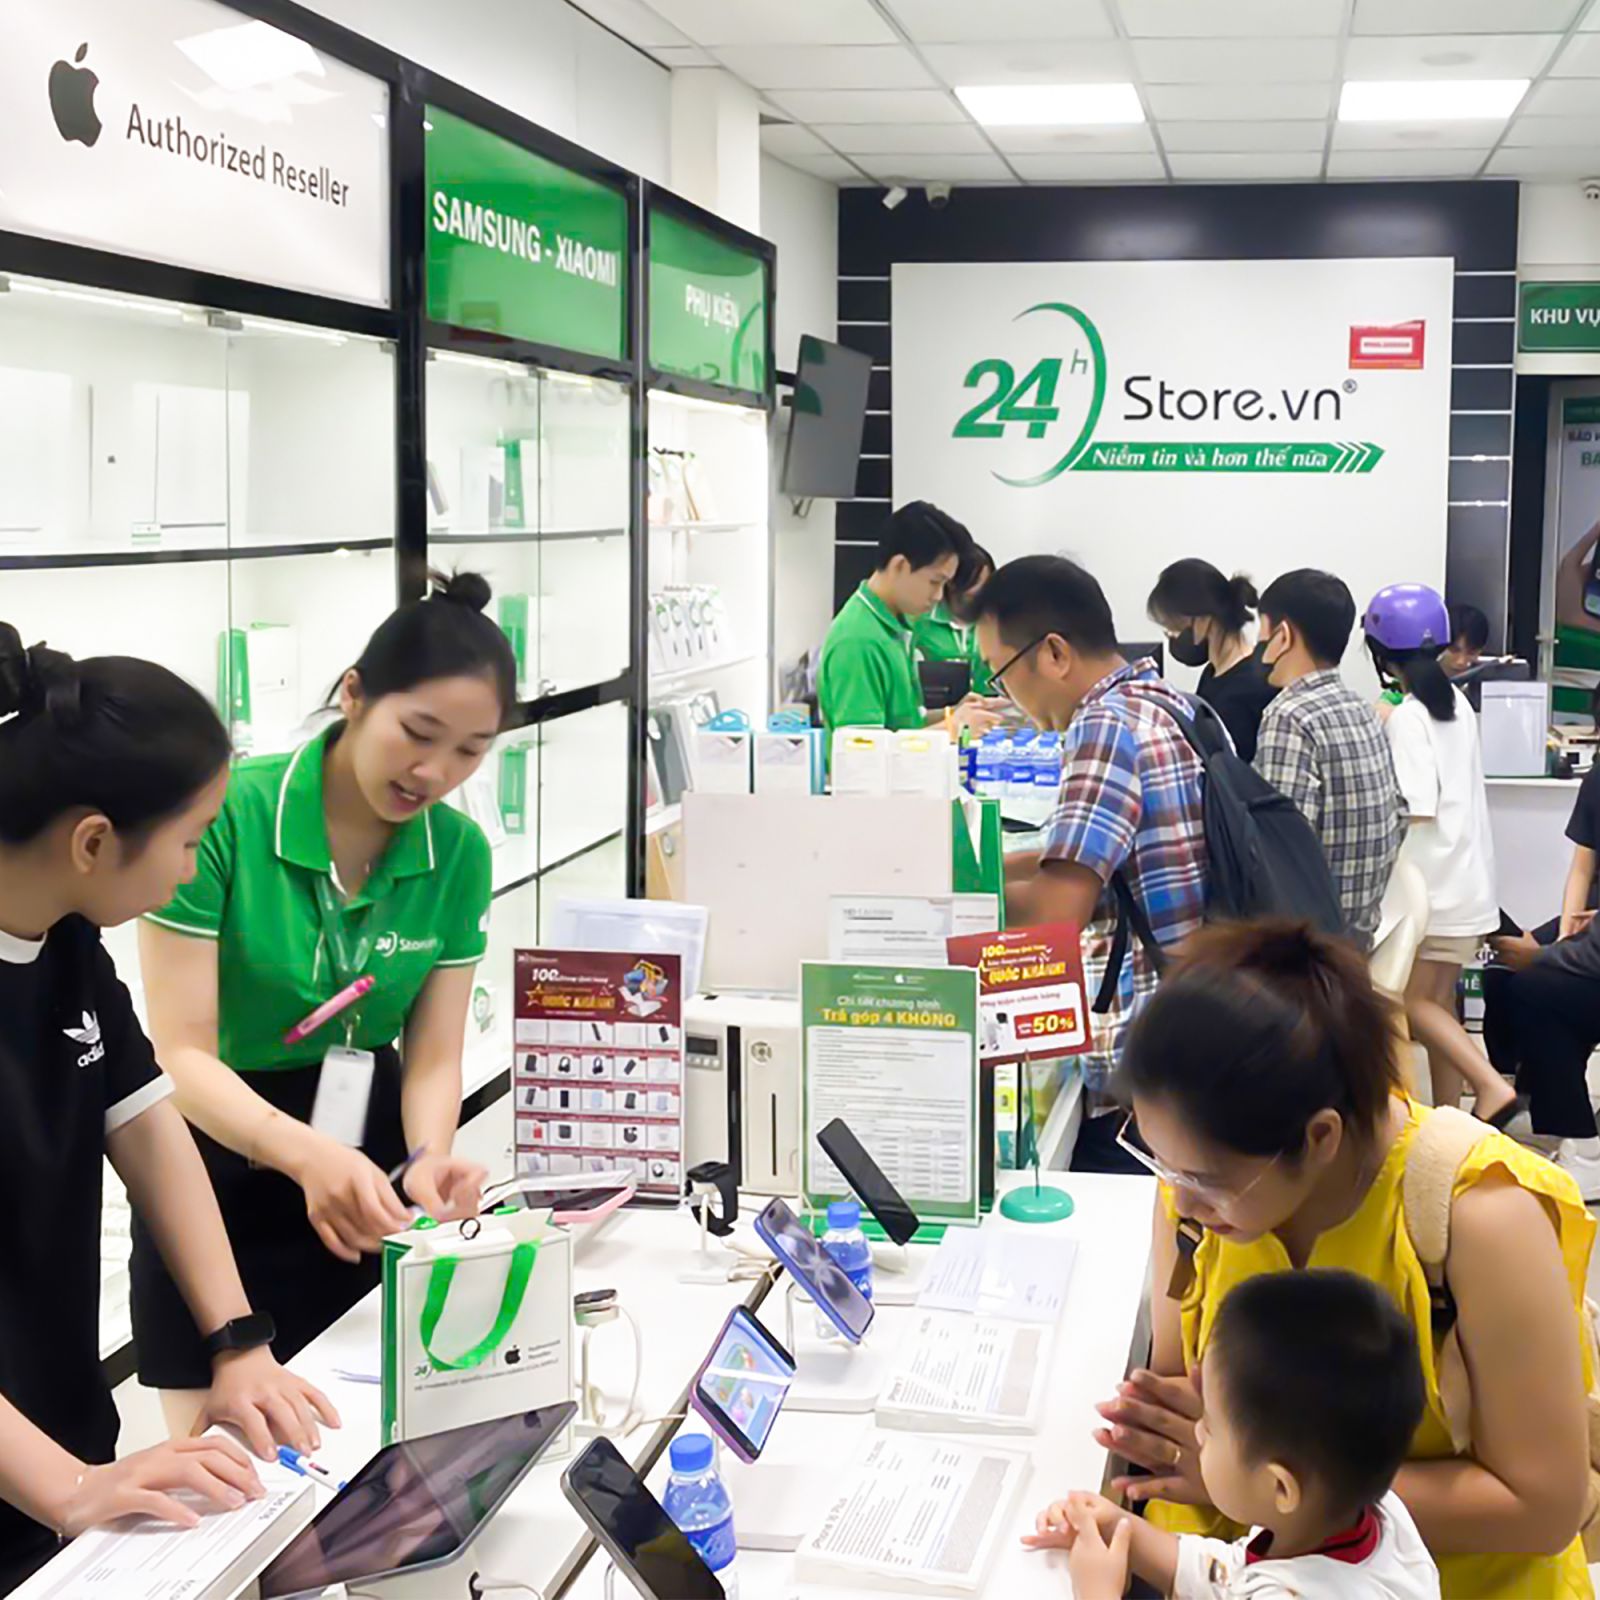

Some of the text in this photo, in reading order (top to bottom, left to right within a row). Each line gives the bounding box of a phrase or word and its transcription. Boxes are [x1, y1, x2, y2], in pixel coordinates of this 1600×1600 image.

[126, 103, 349, 208] Authorized Reseller
[432, 191, 541, 263] SAMSUNG
[555, 234, 616, 287] XIAOMI
[1530, 308, 1570, 325] KHU
[1152, 448, 1178, 466] tin
[1184, 448, 1206, 466] và
[1255, 445, 1293, 466] thế
[850, 1009, 880, 1026] góp
[883, 1012, 894, 1024] 4
[896, 1010, 956, 1028] KHÔNG
[1032, 1014, 1074, 1034] 50%
